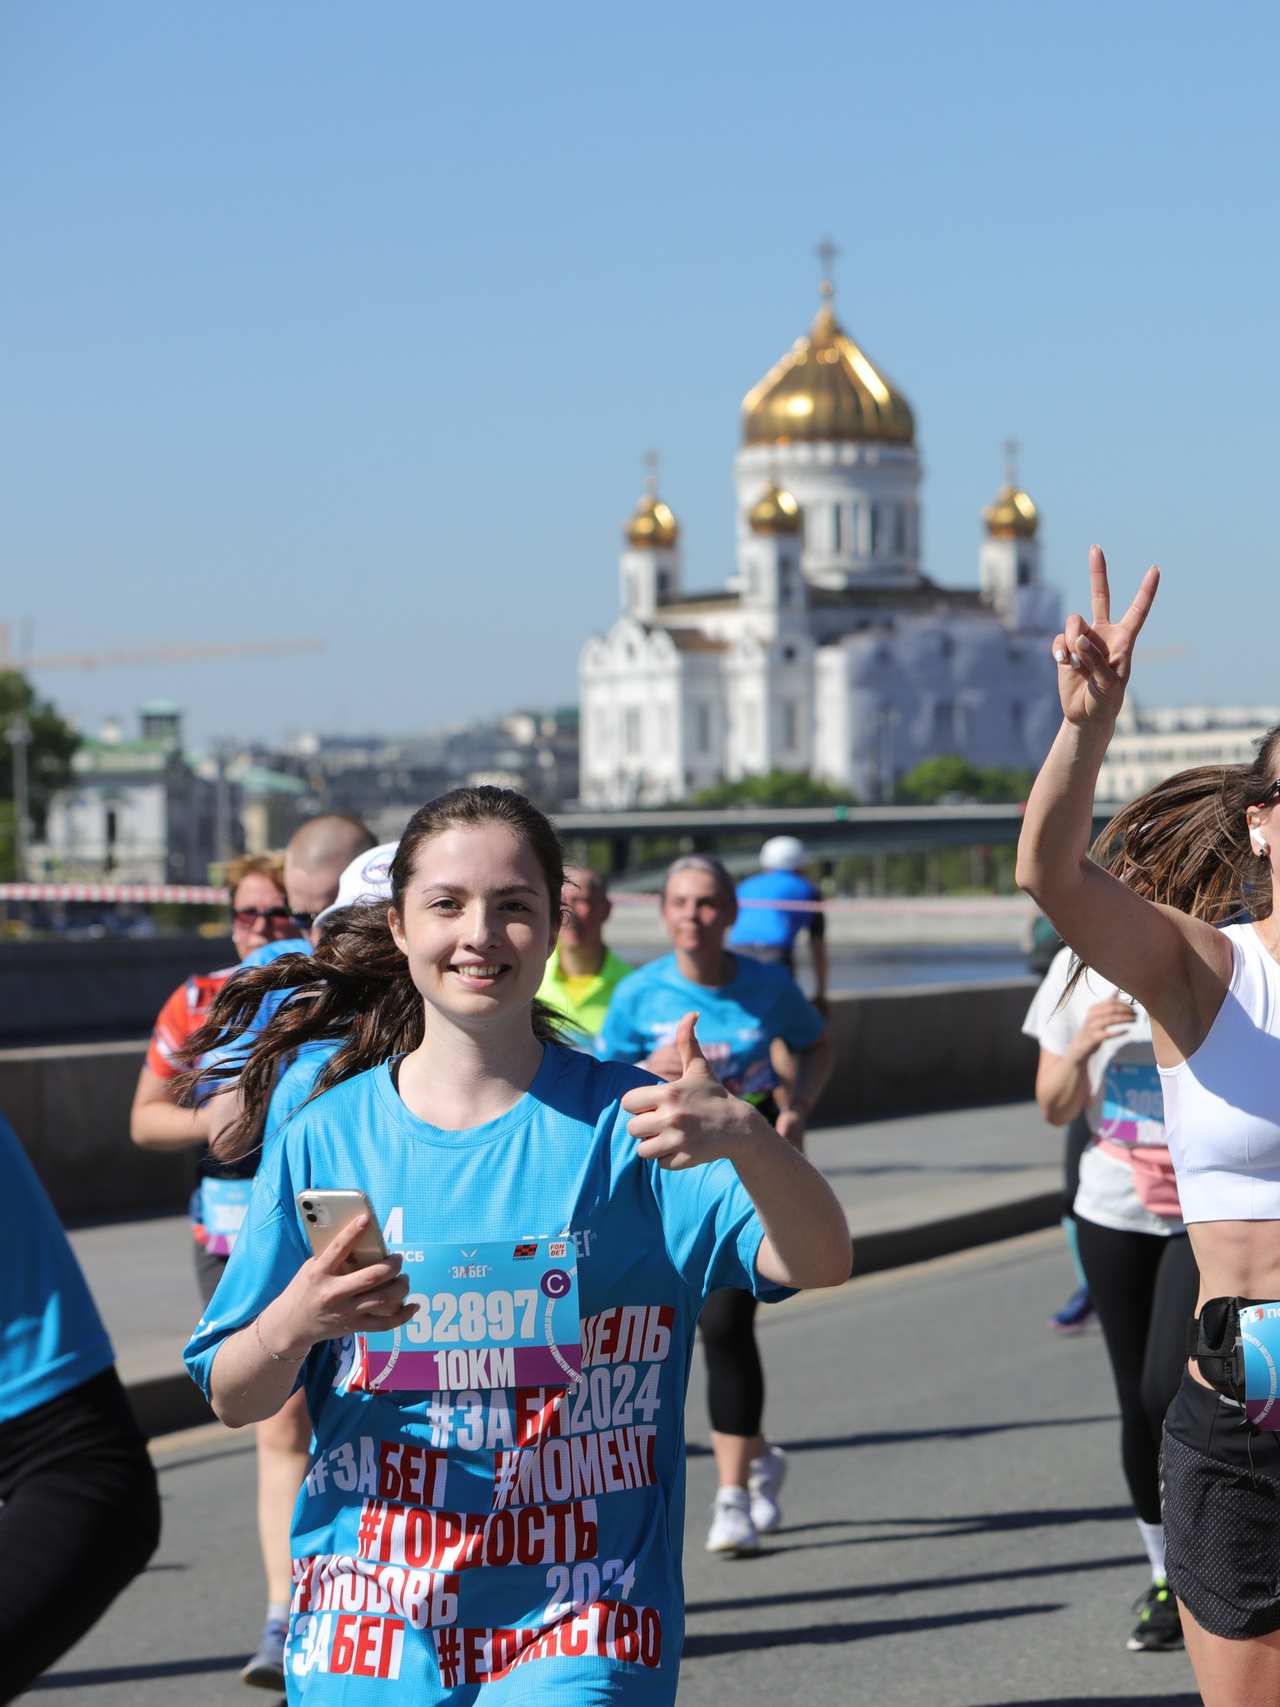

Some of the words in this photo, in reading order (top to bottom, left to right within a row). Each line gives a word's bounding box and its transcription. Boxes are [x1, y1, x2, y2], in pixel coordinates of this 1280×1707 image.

[1125, 1087, 1163, 1118] 305
[403, 1289, 538, 1344] 32897
[307, 1437, 448, 1507] #ЗАБЕГ
[355, 1498, 598, 1572] #ГОРДОСТЬ
